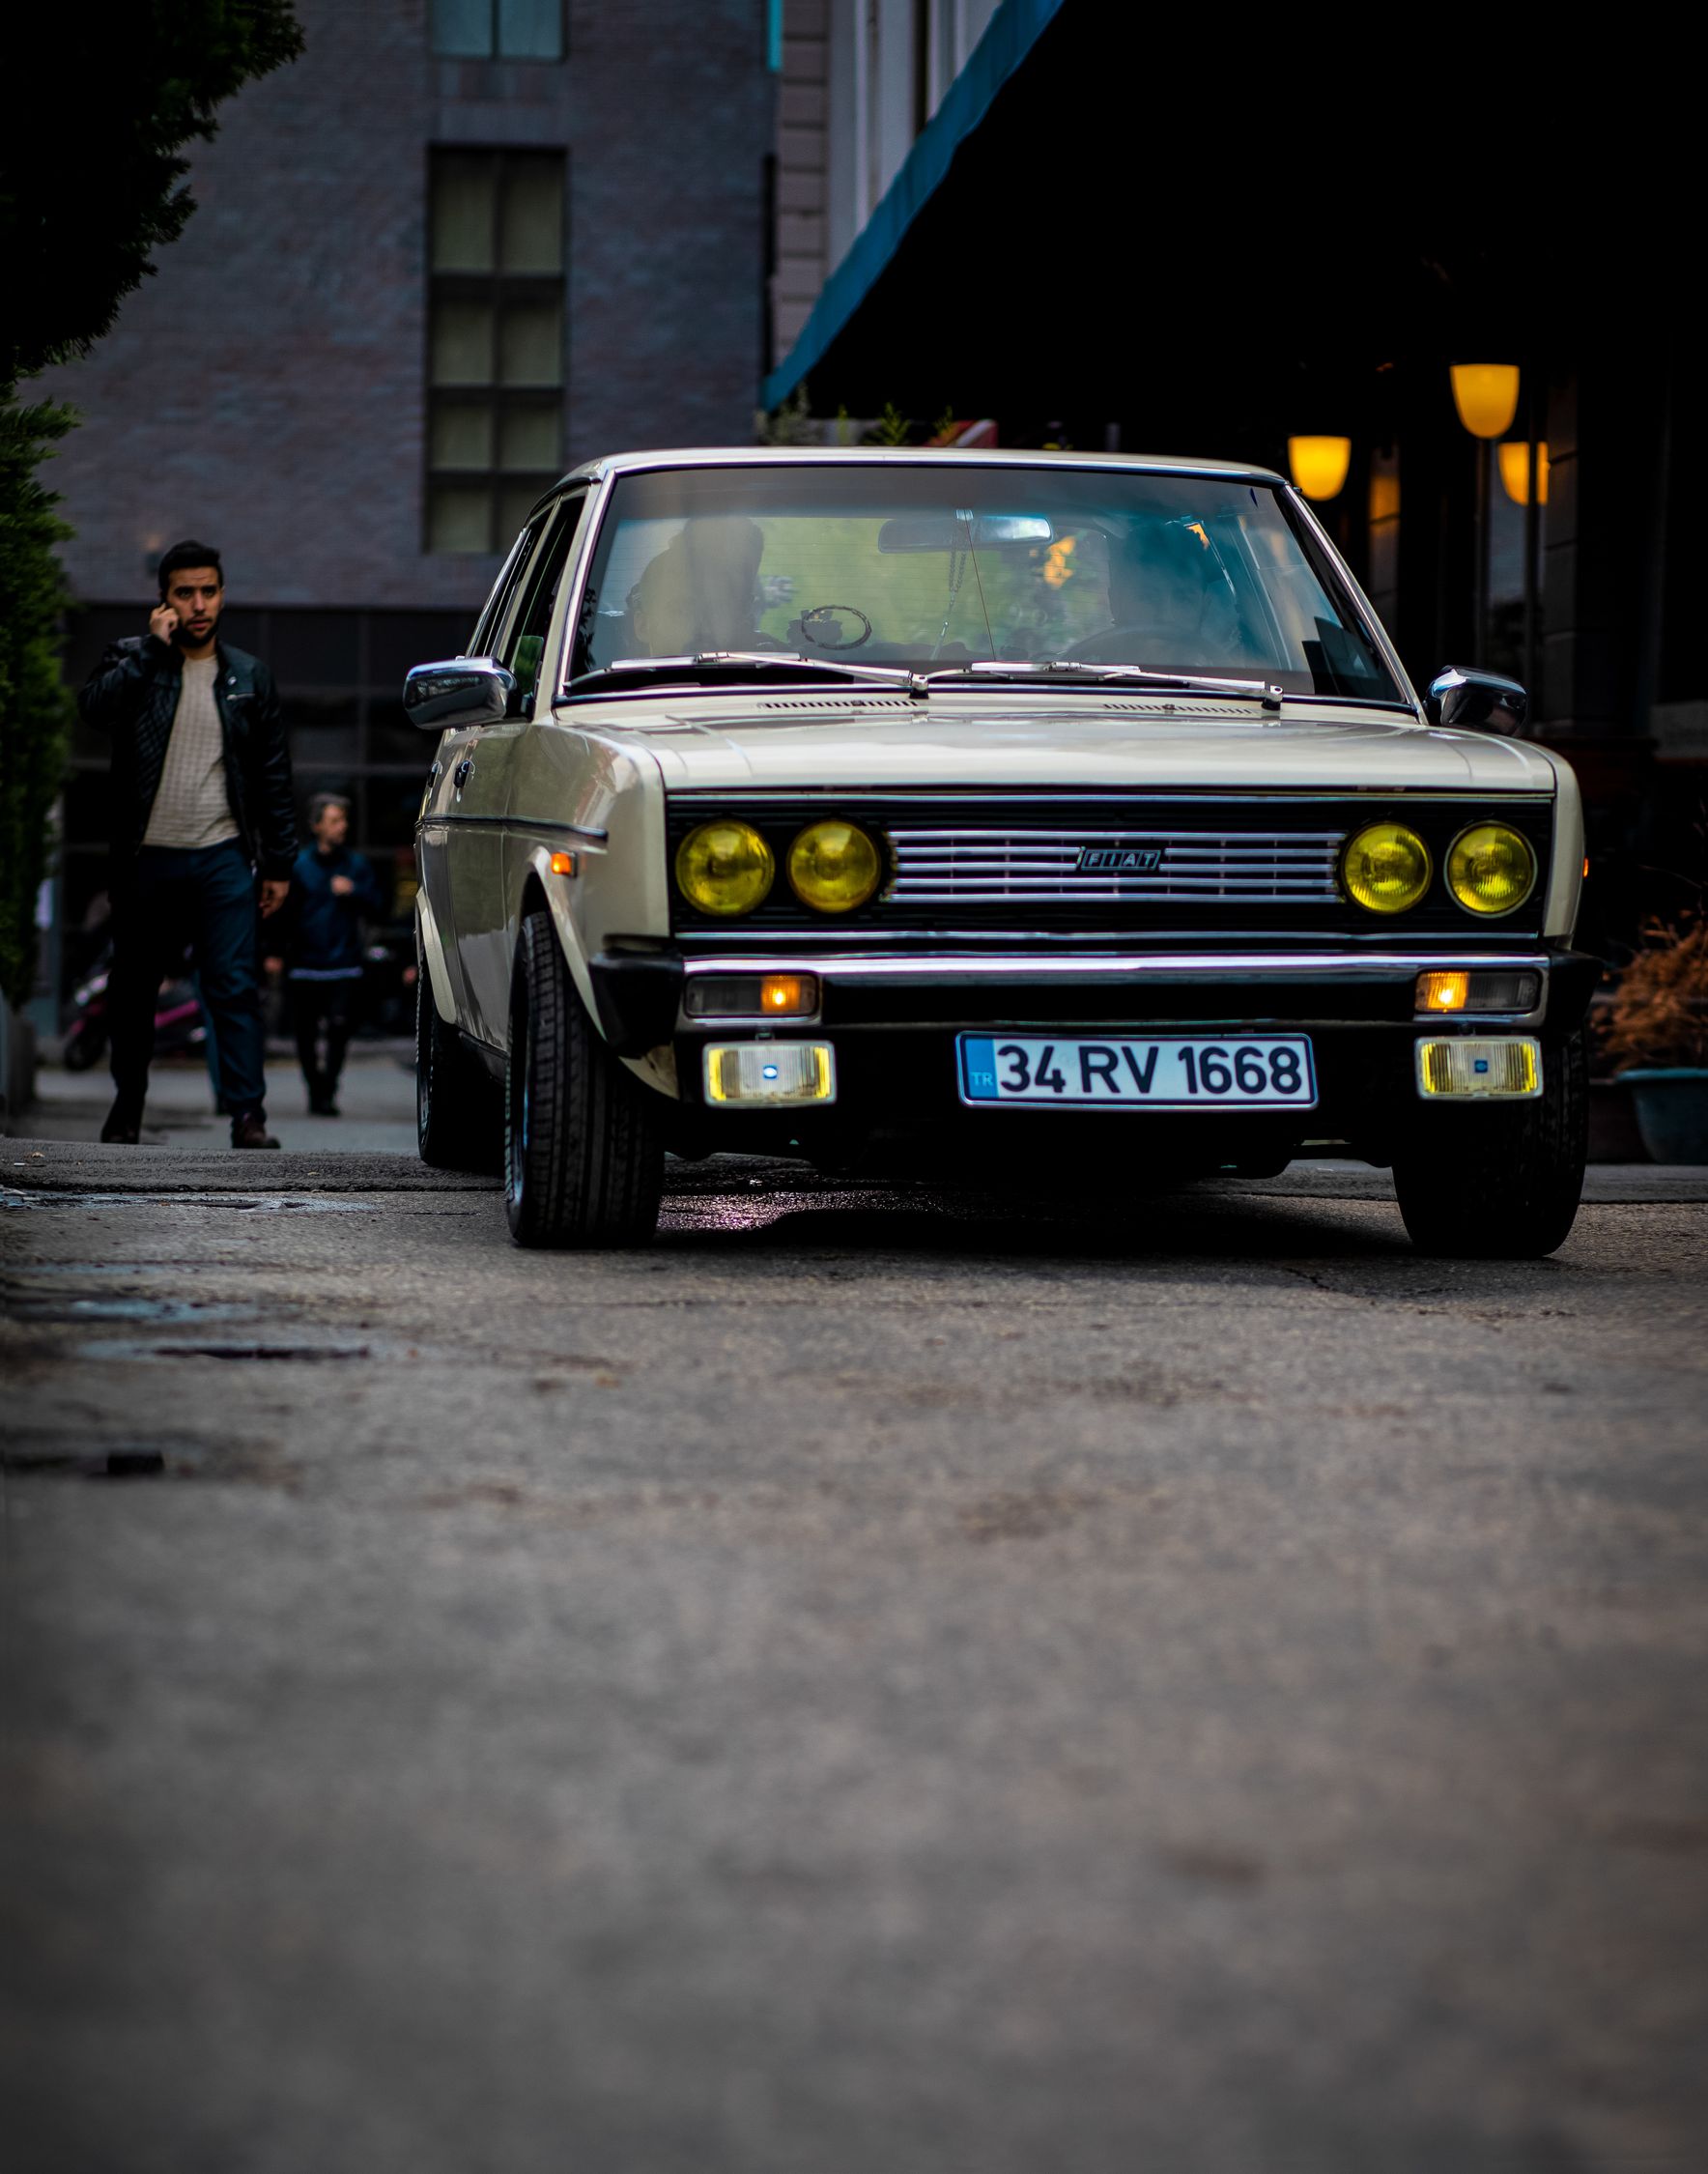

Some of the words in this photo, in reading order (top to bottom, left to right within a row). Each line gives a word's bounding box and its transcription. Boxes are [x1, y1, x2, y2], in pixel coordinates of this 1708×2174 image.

[1087, 852, 1155, 867] FIAT
[997, 1044, 1066, 1093] 34
[1078, 1045, 1159, 1094] RV
[1178, 1045, 1302, 1094] 1668
[970, 1072, 994, 1088] TR
